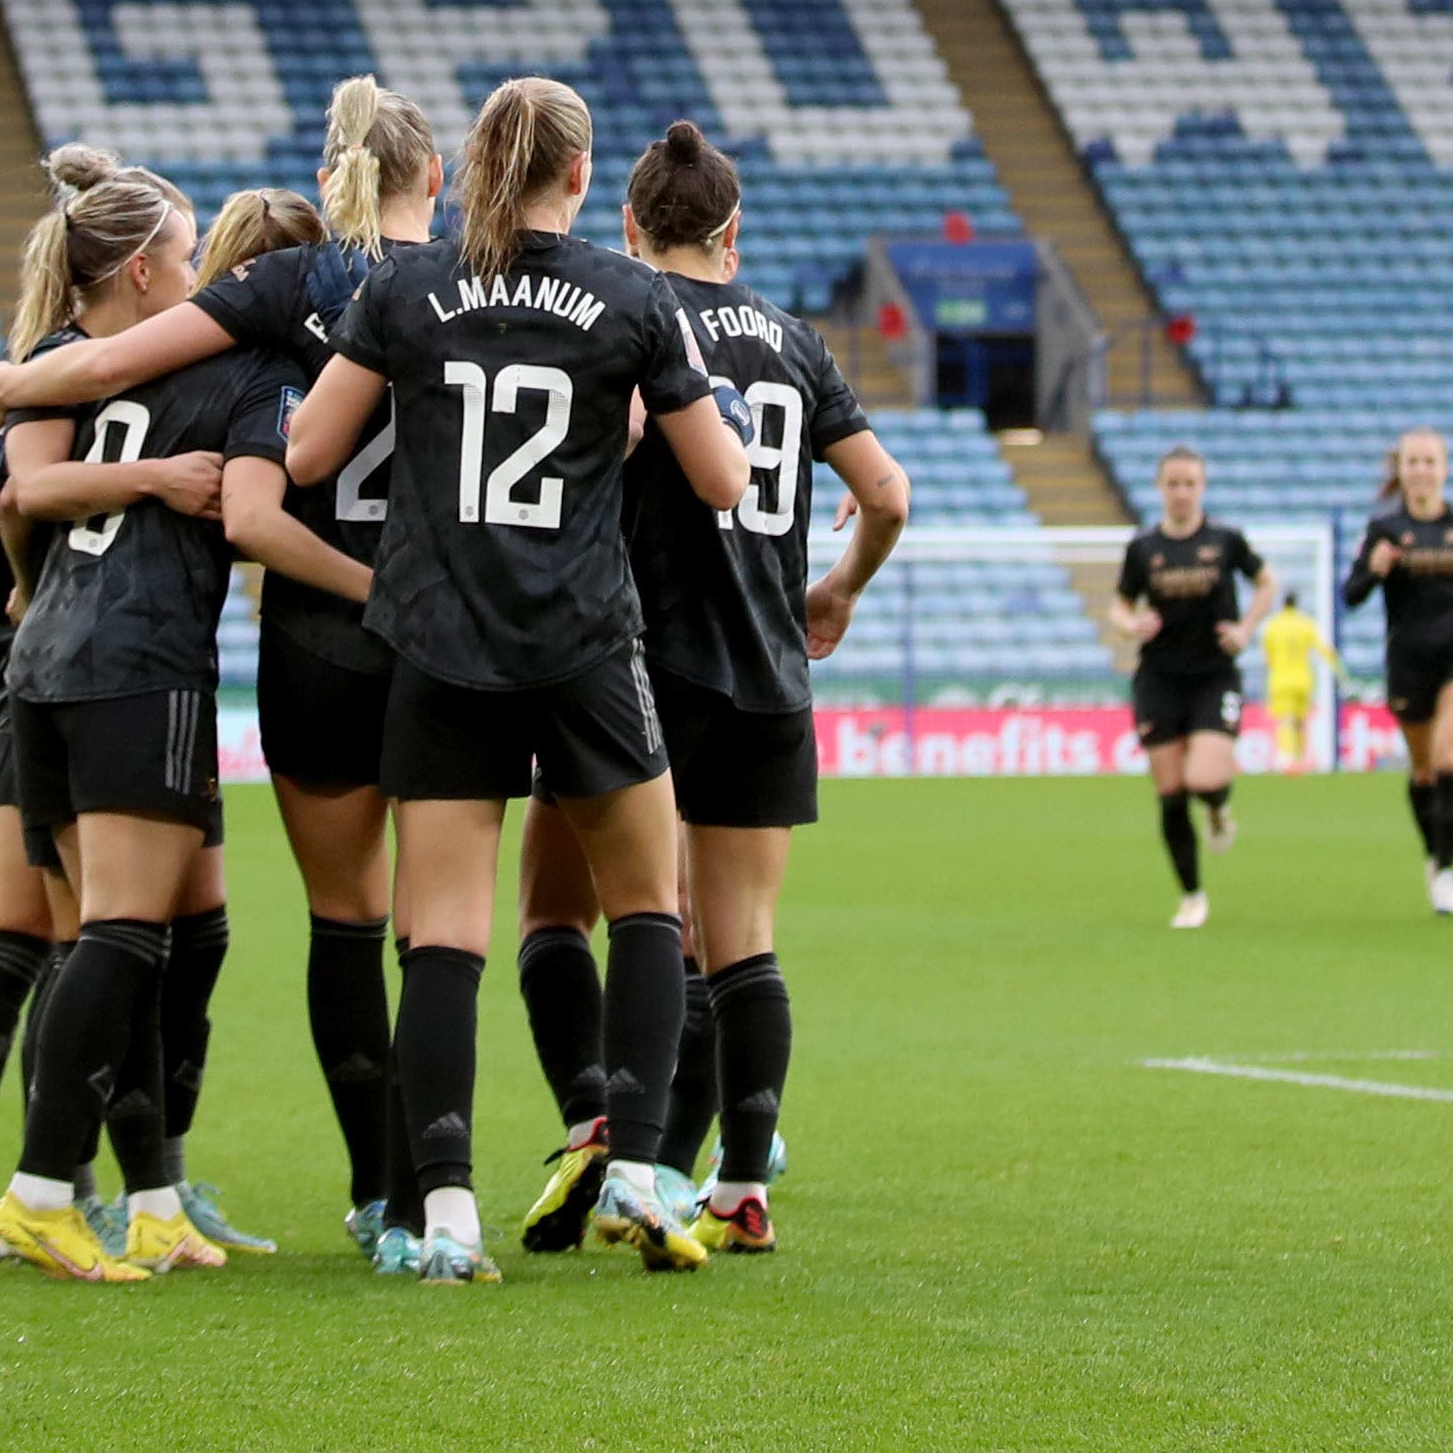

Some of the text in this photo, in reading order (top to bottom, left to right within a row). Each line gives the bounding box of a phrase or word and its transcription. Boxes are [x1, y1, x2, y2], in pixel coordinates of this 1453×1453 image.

[427, 275, 606, 332] L.MAANUM
[700, 305, 783, 353] FOORD
[444, 360, 574, 529] 12
[837, 714, 1100, 777] benefits
